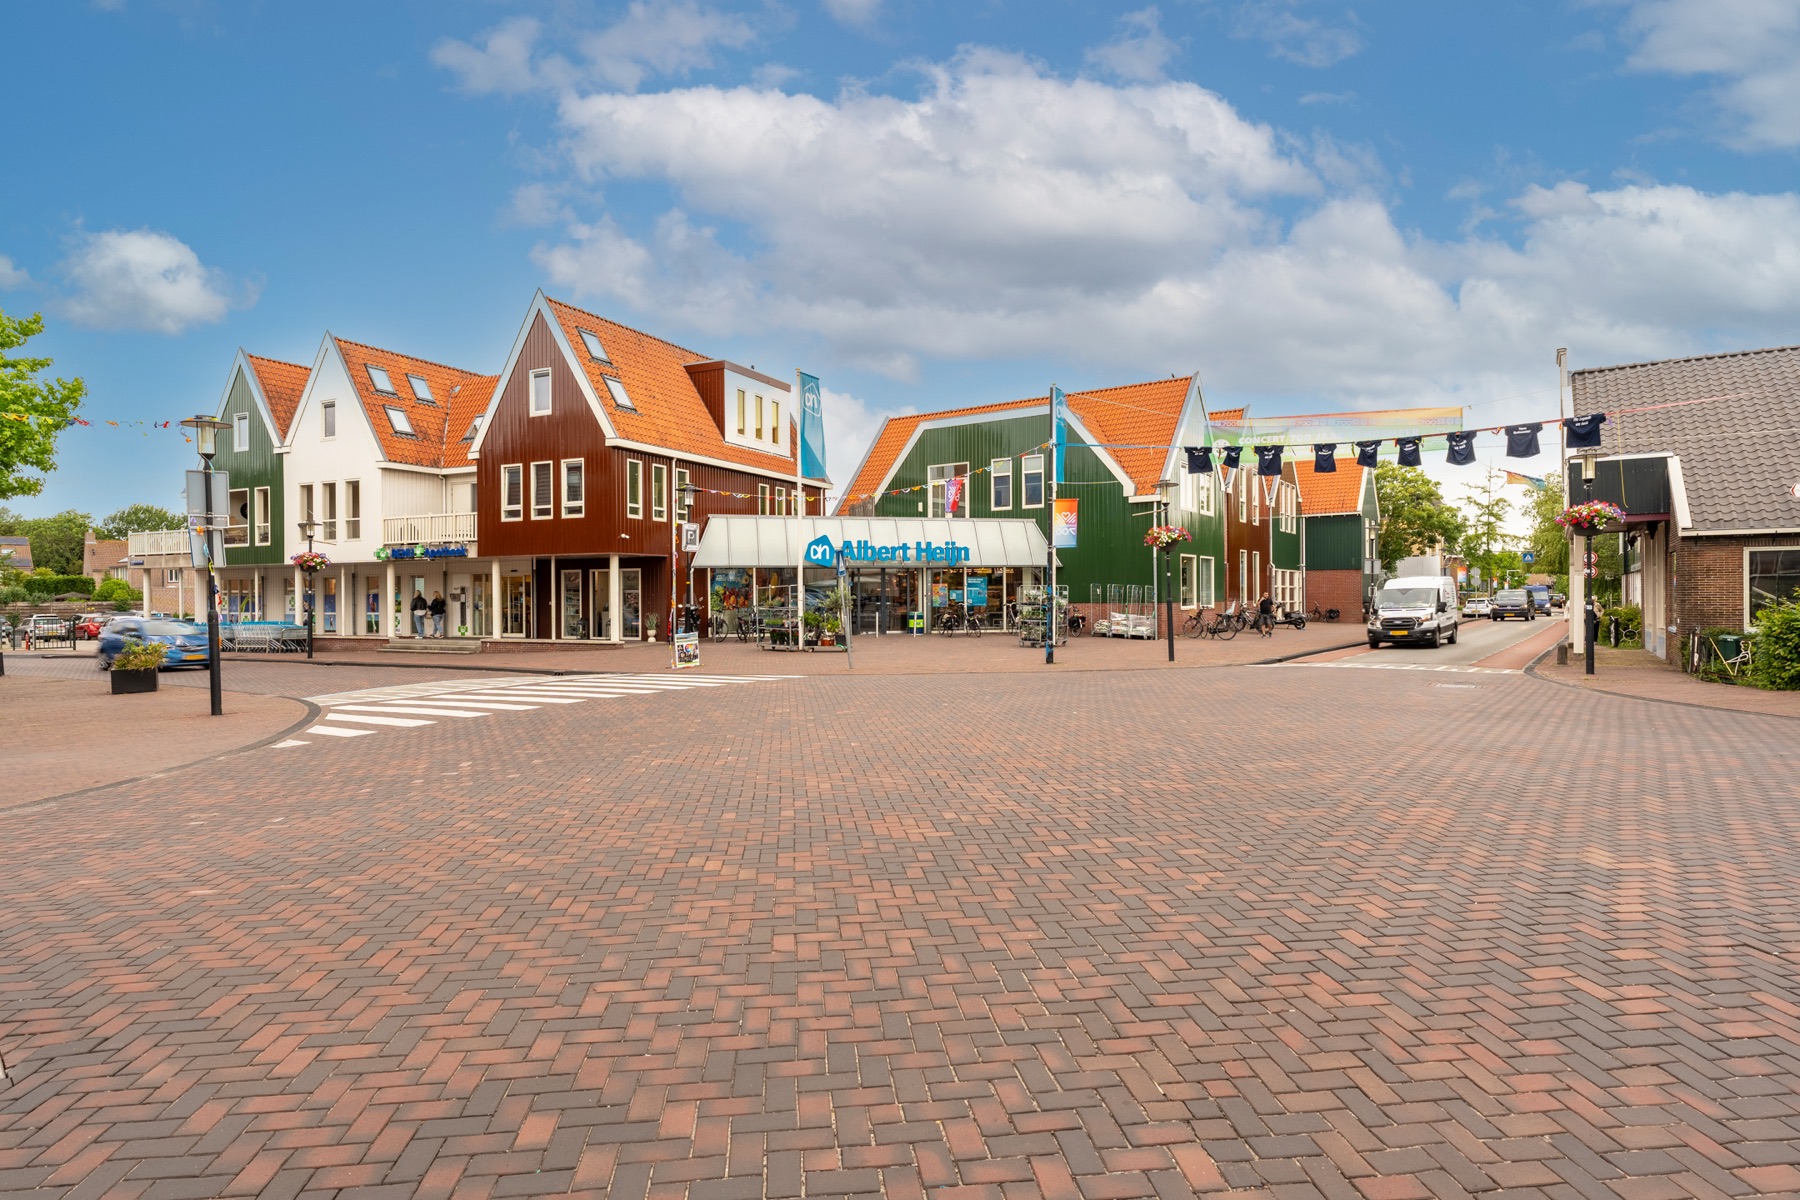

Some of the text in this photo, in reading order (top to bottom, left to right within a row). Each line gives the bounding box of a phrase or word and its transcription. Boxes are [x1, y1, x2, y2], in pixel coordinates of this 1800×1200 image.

[1238, 435, 1285, 445] CONCERT
[841, 540, 910, 562] Albert
[915, 540, 971, 567] Heijn
